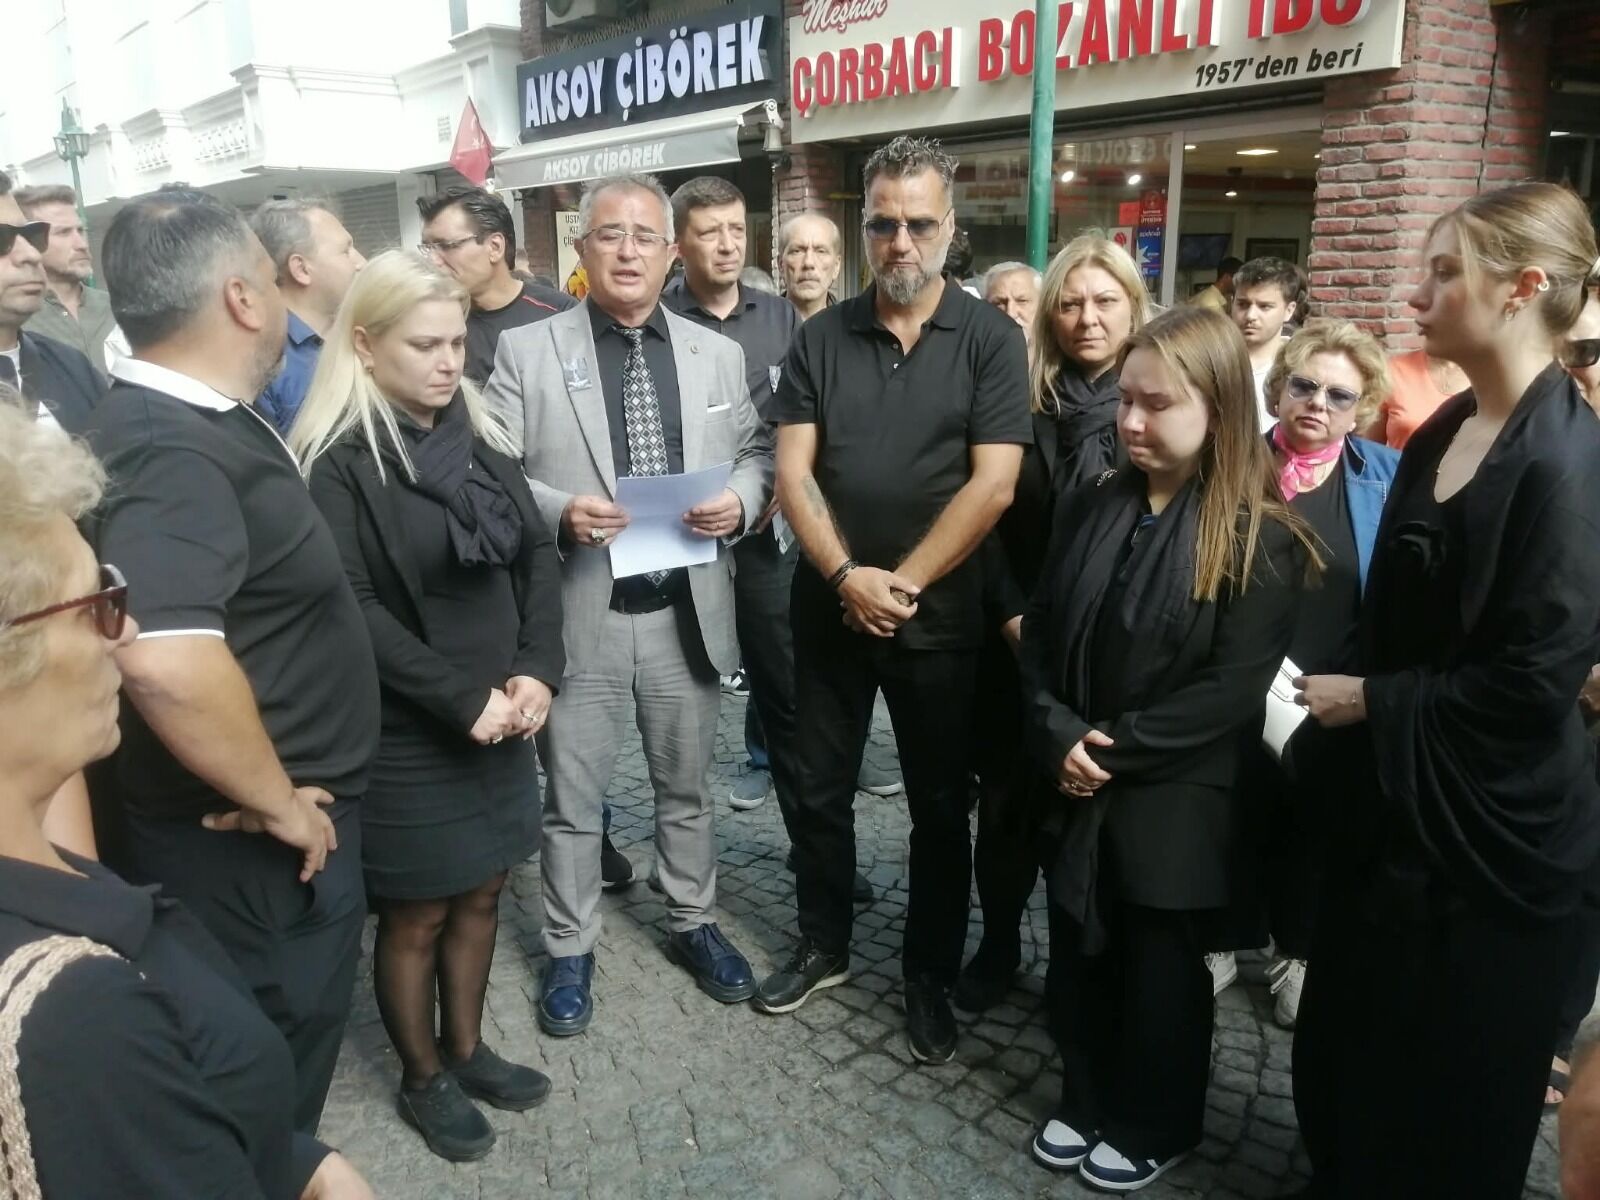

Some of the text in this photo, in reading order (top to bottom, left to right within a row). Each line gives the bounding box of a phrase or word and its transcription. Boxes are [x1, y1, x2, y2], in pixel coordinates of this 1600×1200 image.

[525, 15, 766, 128] AKSOY ÇİBÖREK
[792, 26, 954, 118] ÇORBACI
[1194, 42, 1364, 88] 1957'den beri
[543, 142, 666, 181] AKSOY ÇİBÖREK
